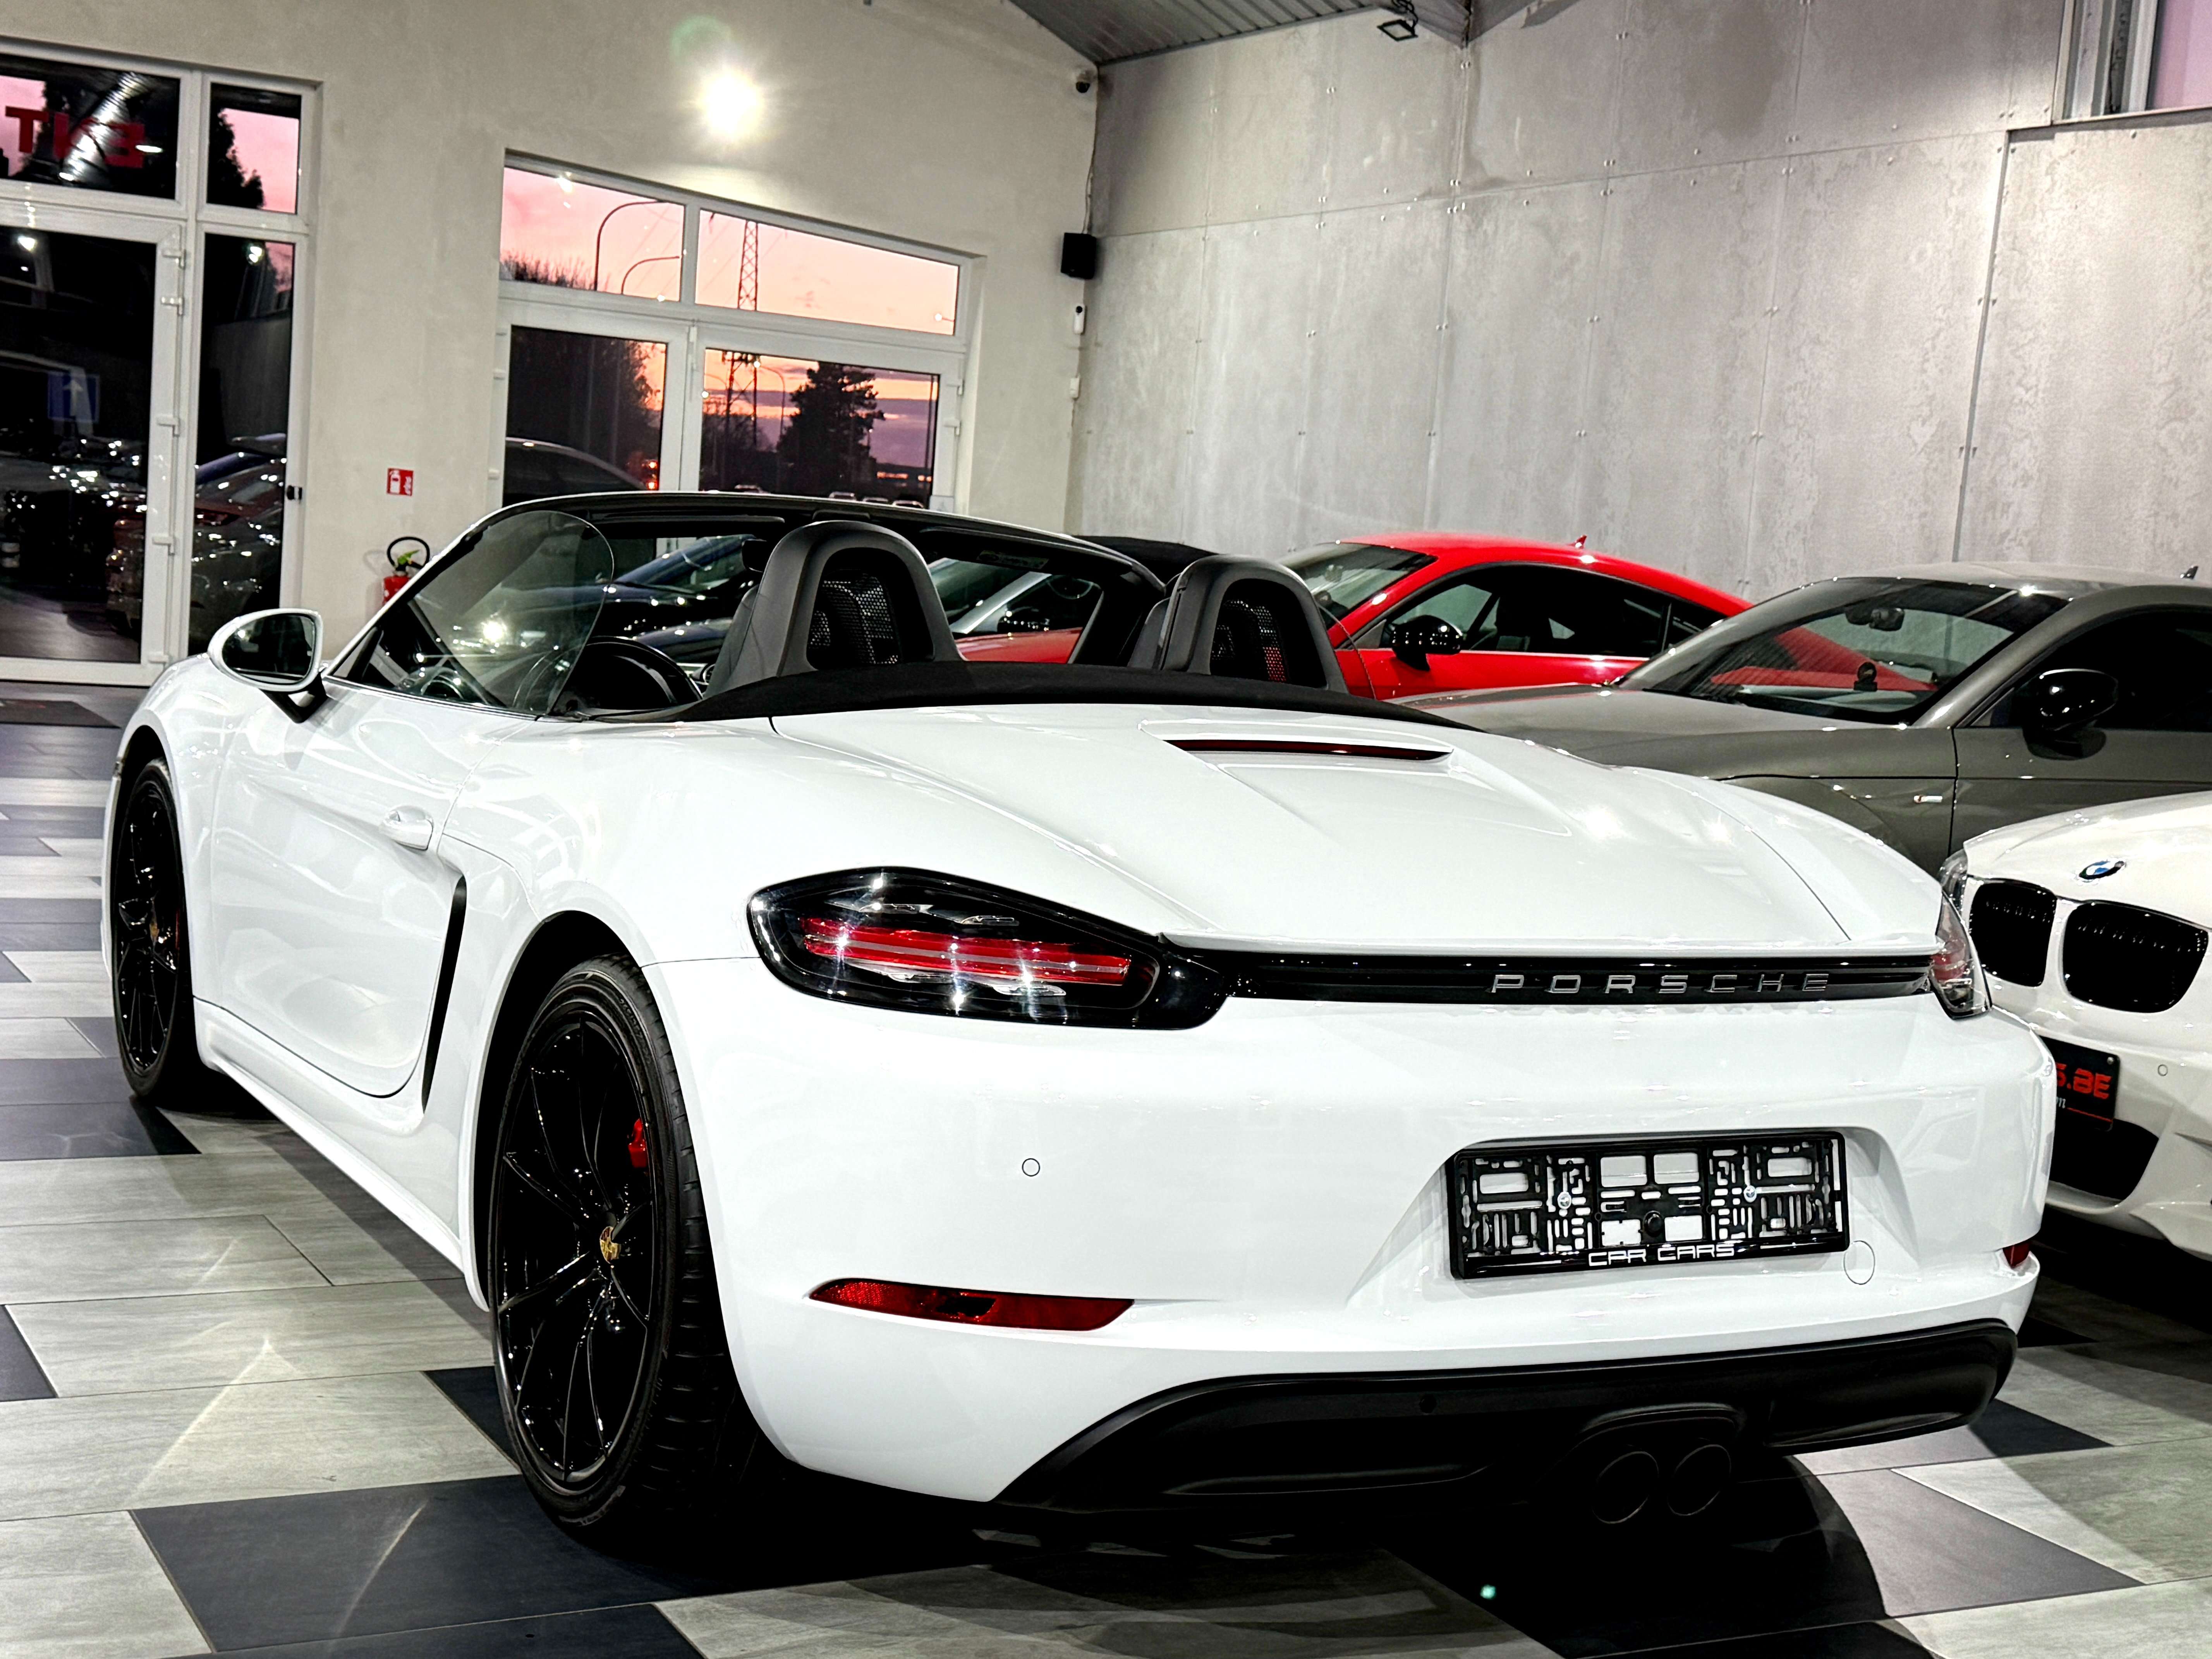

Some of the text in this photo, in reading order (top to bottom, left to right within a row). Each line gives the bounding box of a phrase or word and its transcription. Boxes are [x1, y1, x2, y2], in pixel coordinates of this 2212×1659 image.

[1491, 973, 1829, 994] PORSCHE
[1589, 1243, 1735, 1267] CAR CARS
